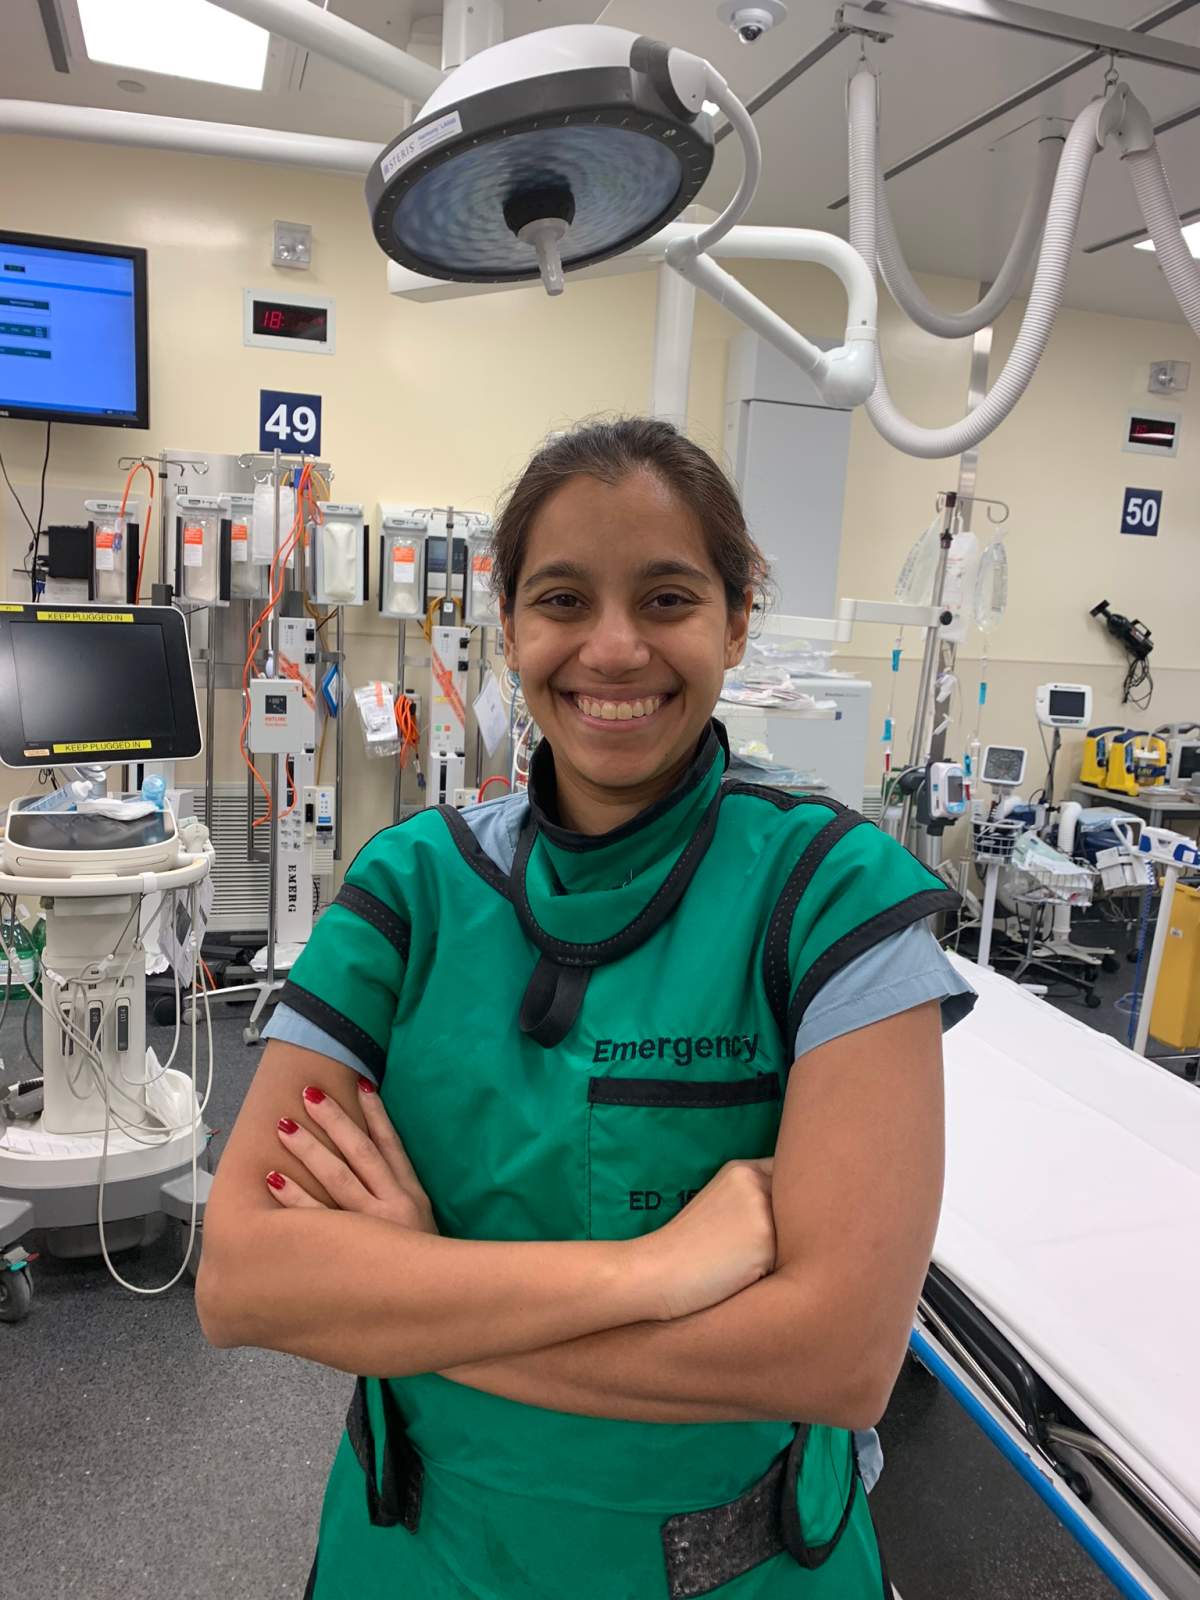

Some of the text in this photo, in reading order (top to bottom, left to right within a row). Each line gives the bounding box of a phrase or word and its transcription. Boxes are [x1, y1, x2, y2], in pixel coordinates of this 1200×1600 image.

[389, 142, 415, 170] STERIS
[264, 404, 316, 443] 49
[1125, 497, 1158, 527] 50
[47, 612, 70, 620] KEEP
[72, 613, 113, 621] PLUGGED
[65, 744, 88, 752] KEEP
[90, 742, 131, 750] PLUGGED
[288, 865, 297, 913] EMERG
[592, 1033, 759, 1066] Emergency
[628, 1190, 662, 1211] ED
